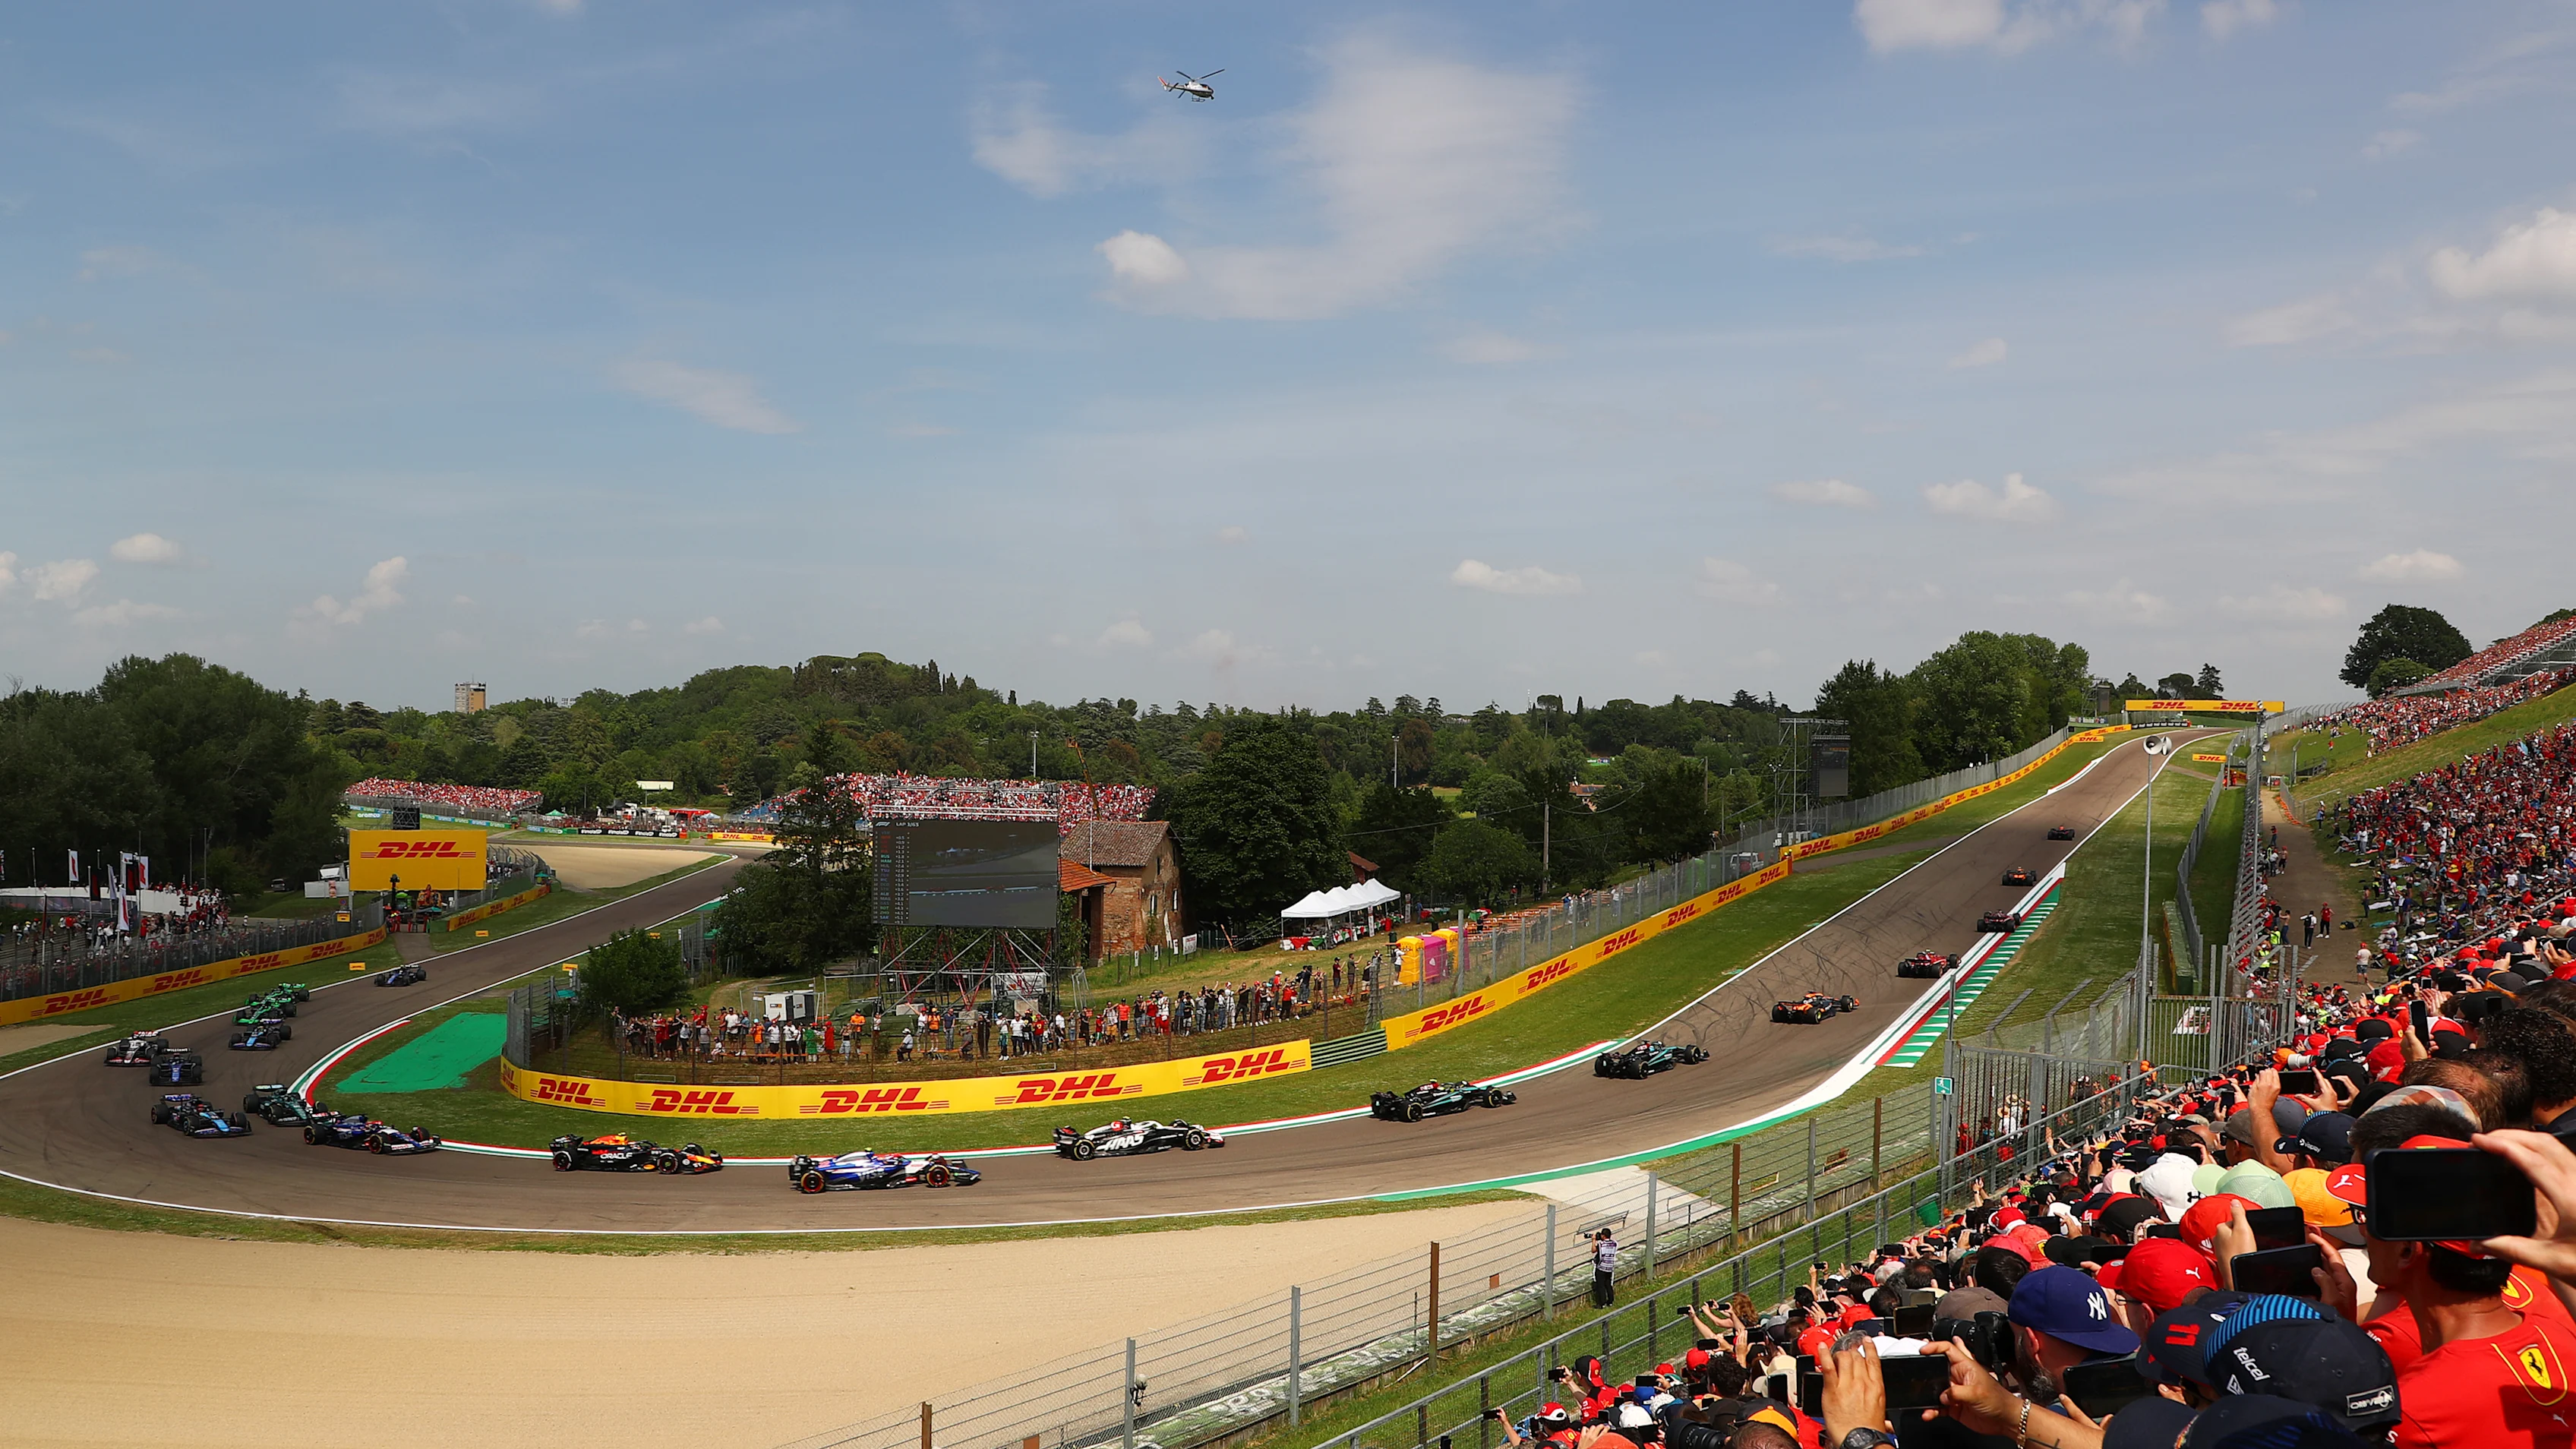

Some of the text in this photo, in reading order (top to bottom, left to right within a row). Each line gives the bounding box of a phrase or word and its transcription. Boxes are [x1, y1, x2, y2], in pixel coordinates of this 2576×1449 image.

[1853, 826, 1881, 843] DHL
[377, 841, 461, 858] DHL
[1800, 839, 1833, 857] DHL
[1760, 867, 1781, 885] DHL
[1716, 883, 1742, 904] DHL
[1666, 902, 1696, 927] DHL
[311, 941, 345, 958] DHL
[1602, 929, 1639, 955] DHL
[240, 954, 282, 973] DHL
[1526, 958, 1570, 990] DHL
[154, 970, 204, 991] DHL
[45, 988, 109, 1014] DHL
[1419, 996, 1485, 1033] DHL
[1201, 1050, 1290, 1083] DHL
[537, 1078, 592, 1105] DHL
[819, 1088, 930, 1113] DHL
[1015, 1074, 1123, 1103] DHL
[650, 1090, 740, 1113] DHL
[1104, 1135, 1144, 1151] HAAS
[2304, 1141, 2322, 1154] viaplay
[2087, 1291, 2107, 1321] NY
[2233, 1346, 2271, 1381] telcel
